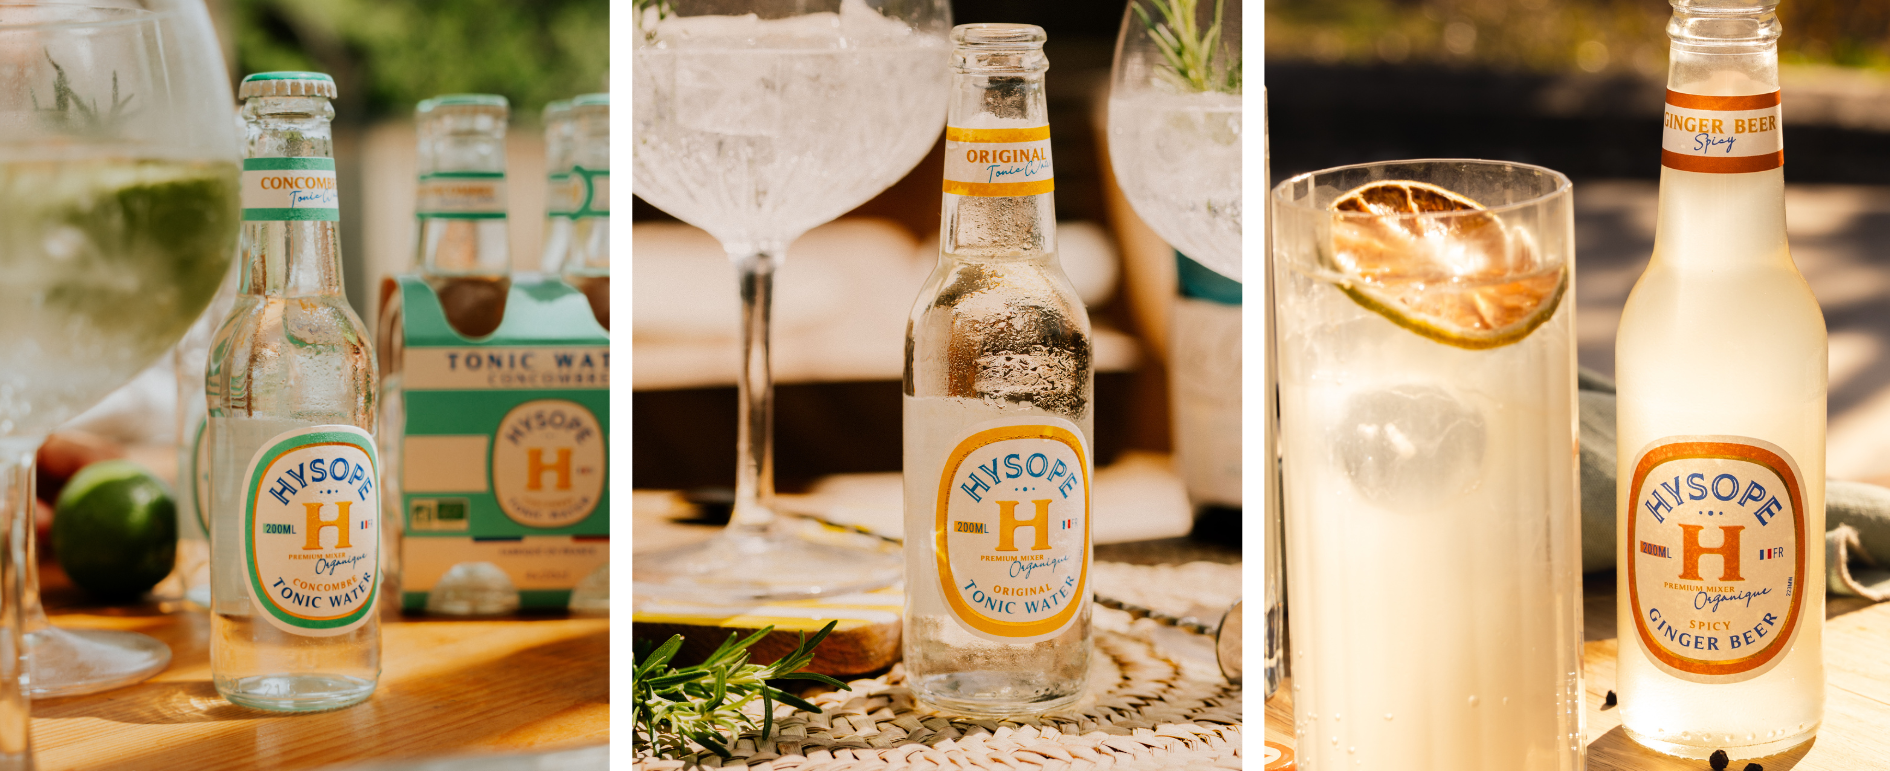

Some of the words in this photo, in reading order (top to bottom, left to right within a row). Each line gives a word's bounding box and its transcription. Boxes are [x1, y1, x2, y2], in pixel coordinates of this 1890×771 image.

[1664, 111, 1725, 135] GINGER
[1733, 115, 1777, 135] BEER
[1693, 132, 1737, 154] Spicy
[966, 147, 1047, 164] ORIGINAL
[986, 164, 1025, 184] Tonic
[289, 190, 322, 208] Tonic
[447, 352, 536, 370] TONIC
[506, 410, 592, 446] HYSOPE
[526, 447, 573, 491] H
[960, 452, 1078, 503] HYSOPE
[268, 457, 373, 506] HYSOPE
[1645, 472, 1783, 527] HYSOPE
[266, 523, 297, 535] 200ML
[302, 501, 353, 550] H
[957, 521, 990, 534] 200ML
[994, 498, 1053, 552] H
[1020, 554, 1044, 562] MIXER
[1642, 541, 1672, 559] 200ML
[1677, 523, 1746, 582] H
[1773, 546, 1784, 559] FR
[315, 552, 367, 576] Organique
[1009, 555, 1070, 580] Organique
[272, 576, 322, 609] TONIC
[328, 571, 371, 608] WATER
[292, 574, 358, 592] CONCOMBRE
[964, 579, 1017, 615] TONIC
[1024, 575, 1075, 614] WATER
[993, 583, 1052, 597] ORIGINAL
[1663, 581, 1703, 592] PREMIUM
[1706, 585, 1735, 593] MIXER
[1694, 587, 1773, 613] Organique
[1649, 607, 1720, 651] GINGER
[1729, 612, 1778, 650] BEER
[1689, 619, 1731, 631] SPICY
